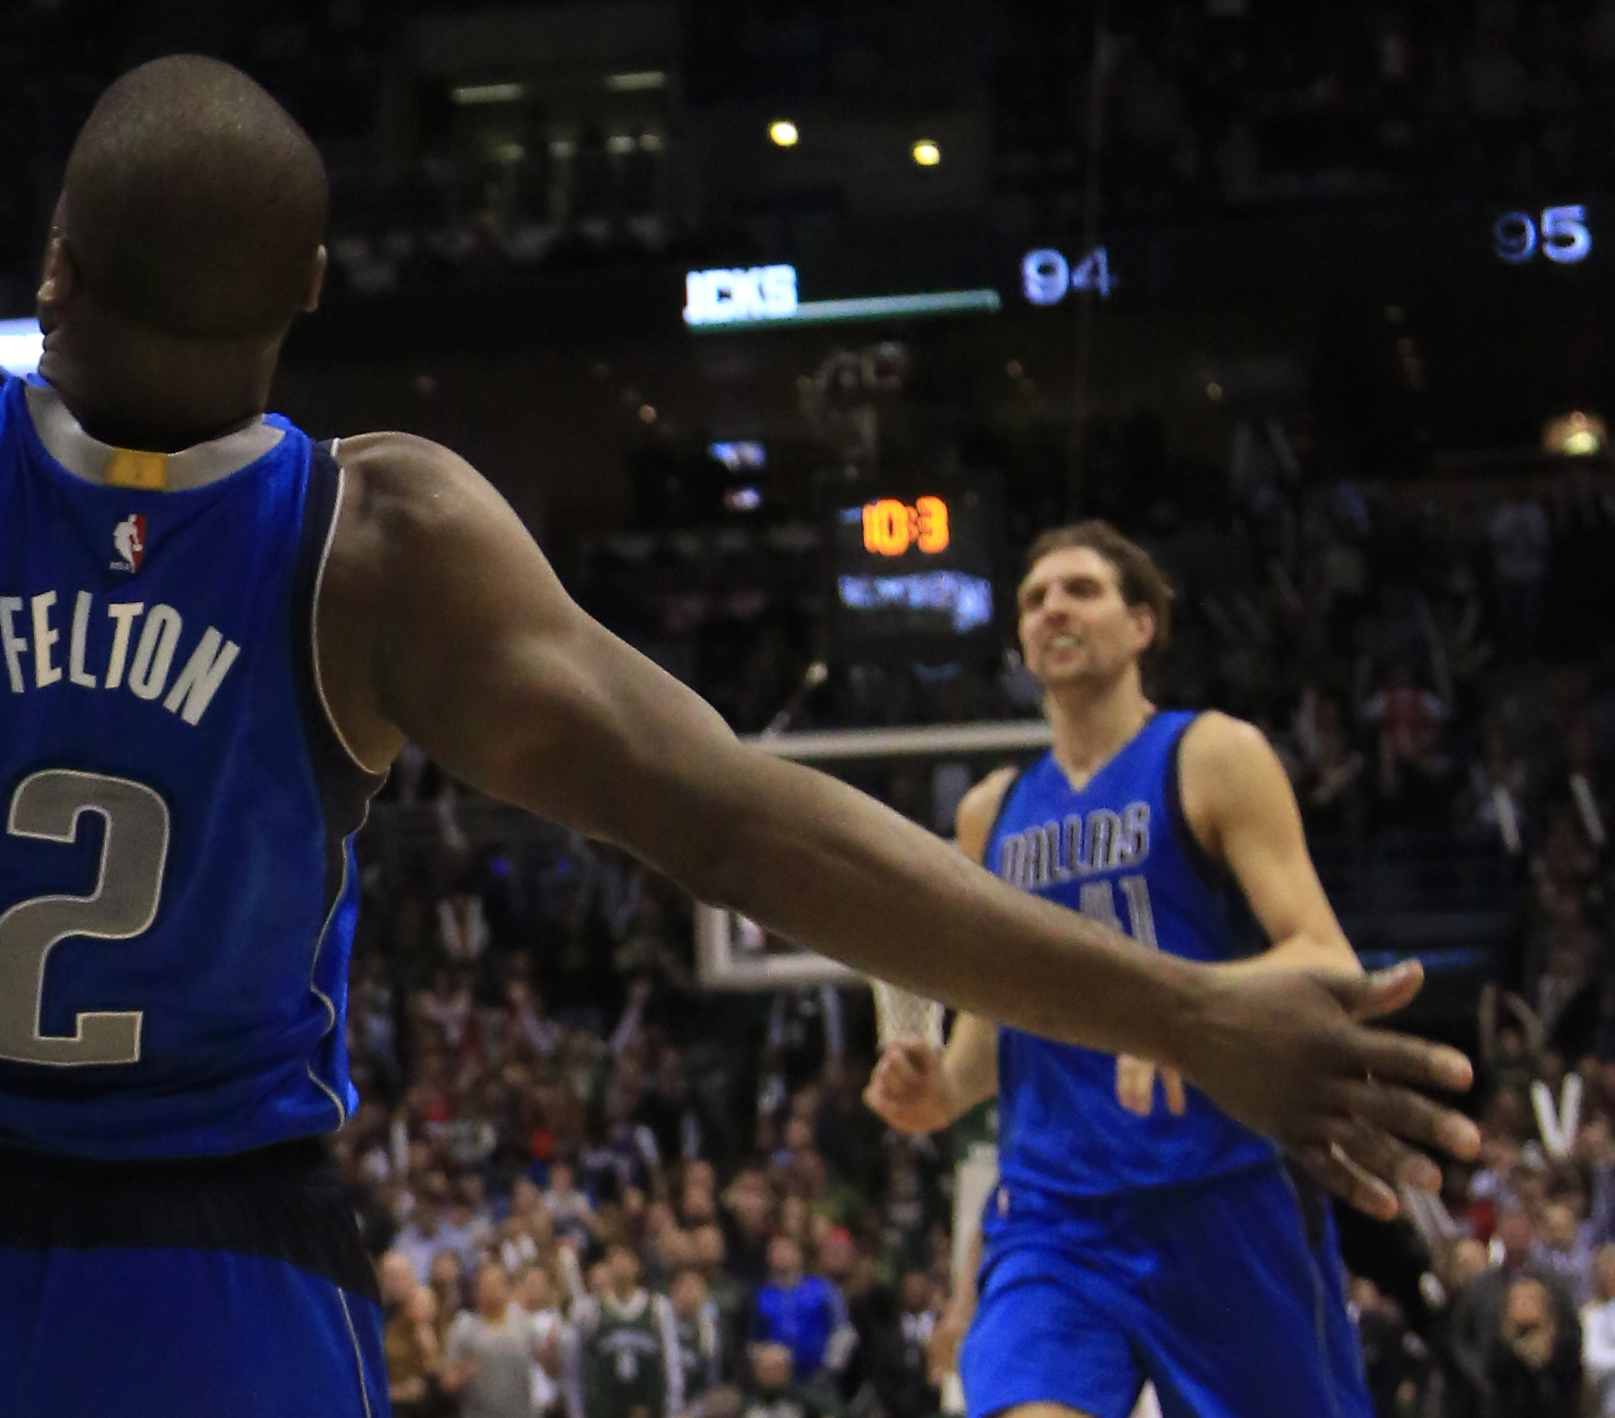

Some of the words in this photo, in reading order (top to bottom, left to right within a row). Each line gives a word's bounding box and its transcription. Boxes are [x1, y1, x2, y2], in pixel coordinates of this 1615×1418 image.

[1493, 204, 1592, 264] 95
[1021, 247, 1117, 306] 94
[999, 800, 1152, 892] DALLAS
